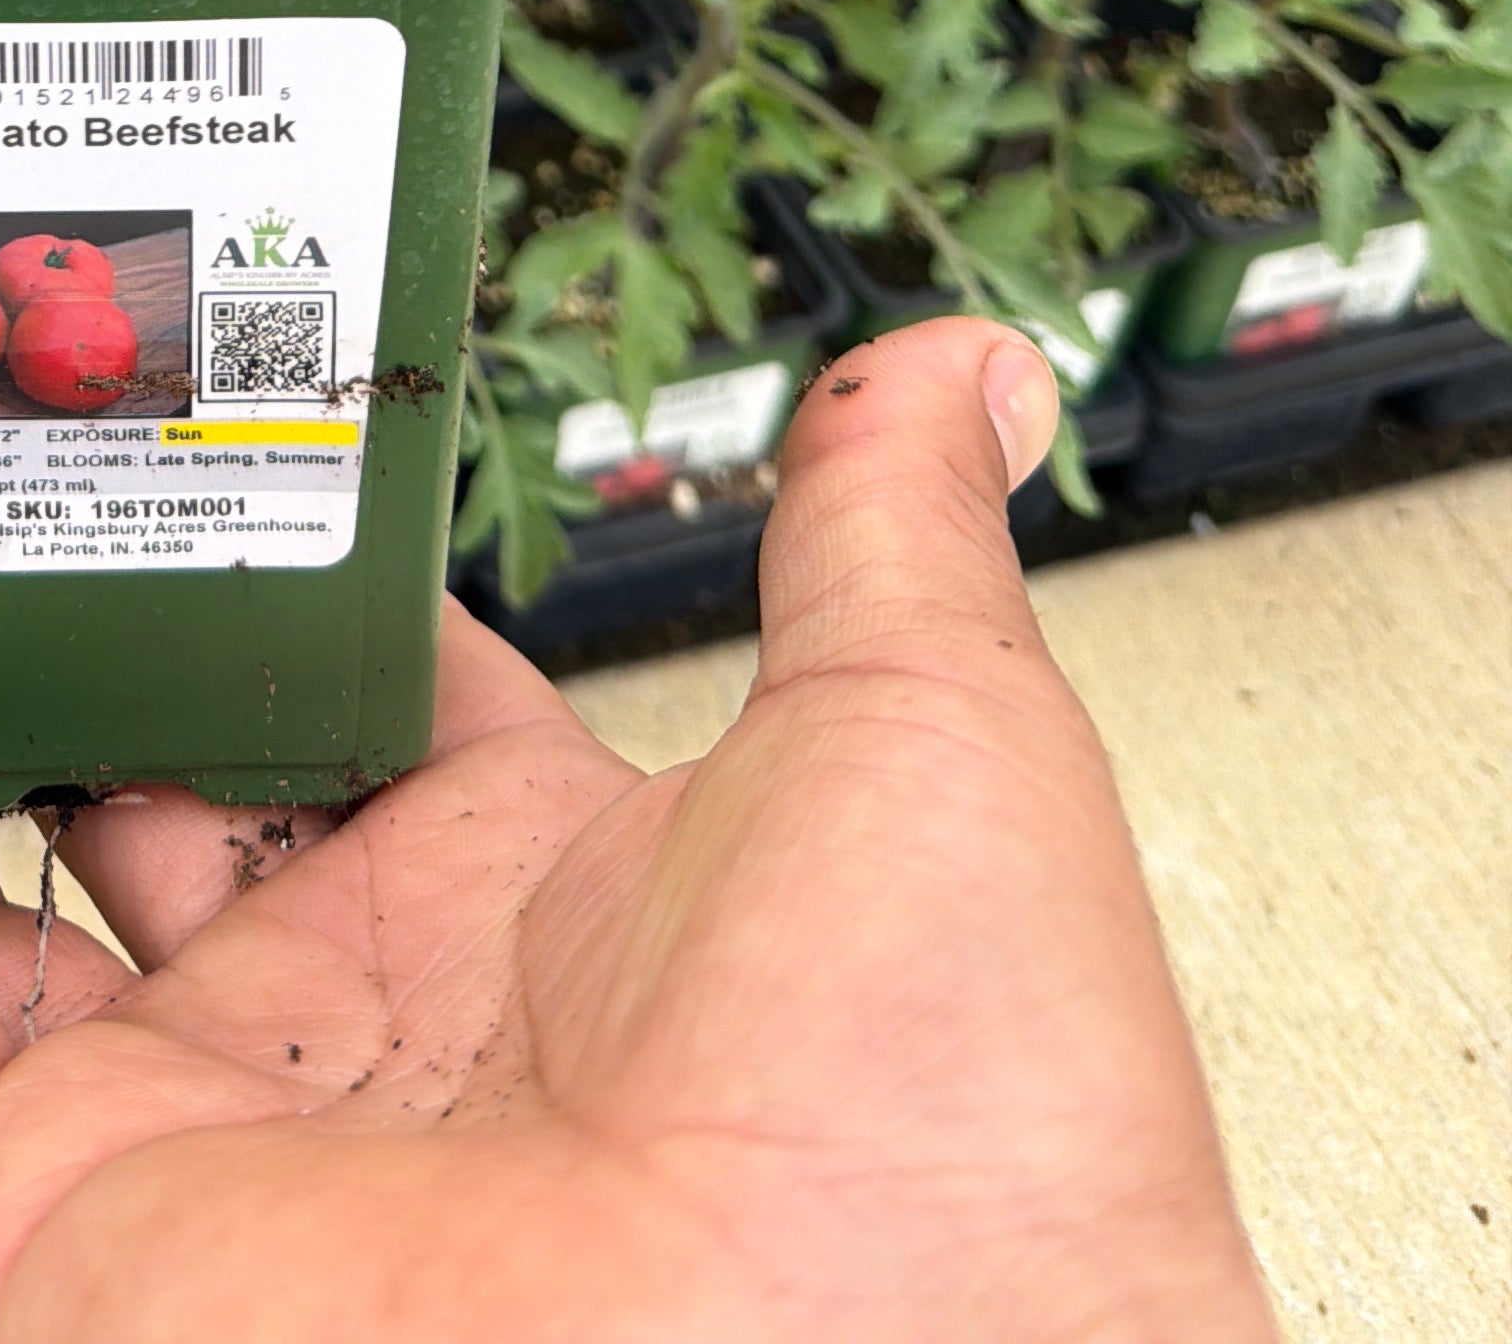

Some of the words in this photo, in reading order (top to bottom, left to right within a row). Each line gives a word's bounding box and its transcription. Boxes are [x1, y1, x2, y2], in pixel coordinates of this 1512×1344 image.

[116, 84, 224, 105] 24496
[279, 86, 291, 100] 5
[84, 113, 297, 147] Beefsteak
[210, 236, 331, 268] AKA
[46, 427, 161, 443] EXPOSURE:
[166, 428, 202, 440] Sun
[47, 453, 138, 468] BLOOMS:
[145, 453, 185, 466] Late
[265, 451, 345, 465] Summer
[21, 478, 59, 494] (473
[6, 501, 71, 519] SKU:
[91, 497, 246, 519] 196TOM001
[54, 521, 148, 538] Kingsbury
[154, 520, 206, 533] Acres
[23, 542, 44, 556] La
[50, 542, 105, 557] Porte,
[140, 540, 194, 554] 46350
